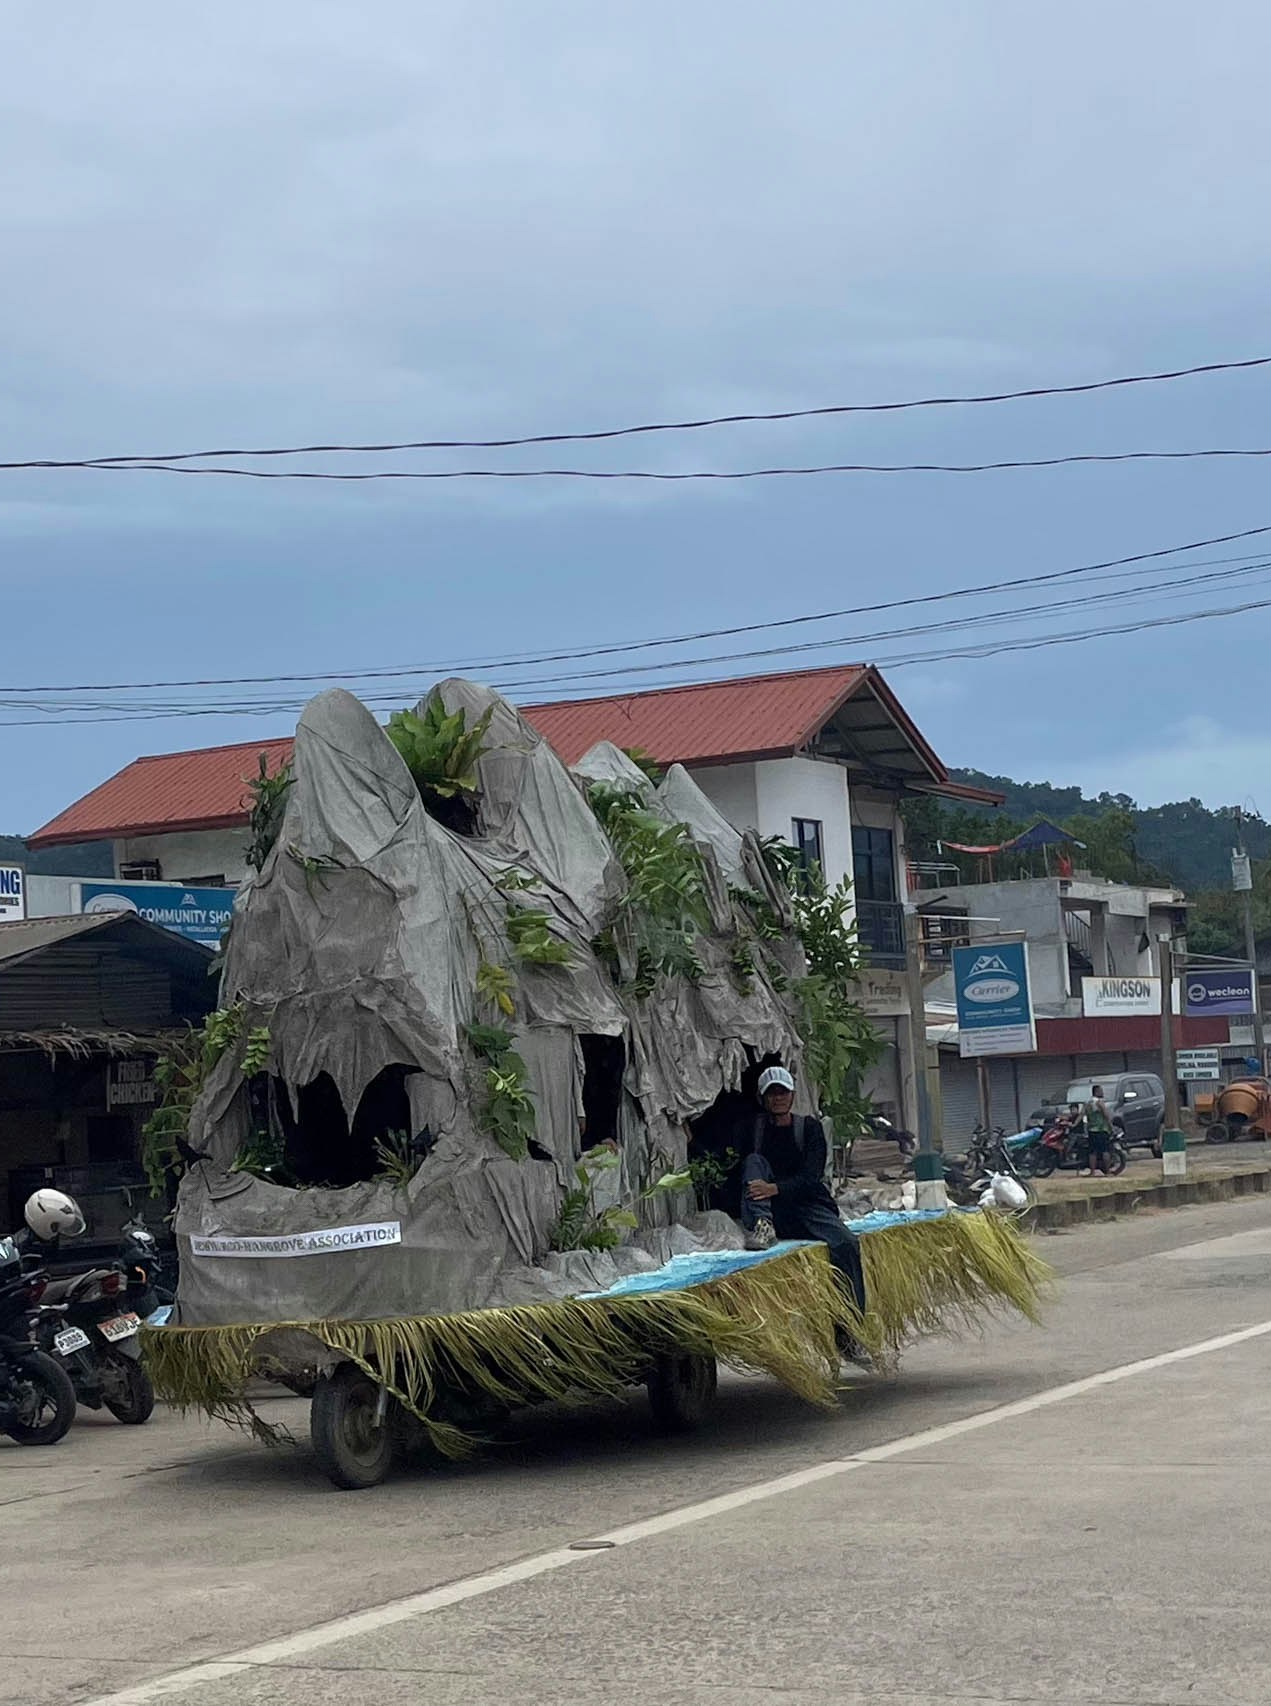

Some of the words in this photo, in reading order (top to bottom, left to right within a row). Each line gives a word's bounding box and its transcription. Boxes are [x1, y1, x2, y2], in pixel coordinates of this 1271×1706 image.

[139, 908, 207, 924] COMMUNITY
[209, 910, 232, 924] SHO
[1101, 979, 1151, 998] KINGSON
[1207, 985, 1250, 997] weclean
[308, 1228, 396, 1249] ASSOCIATION
